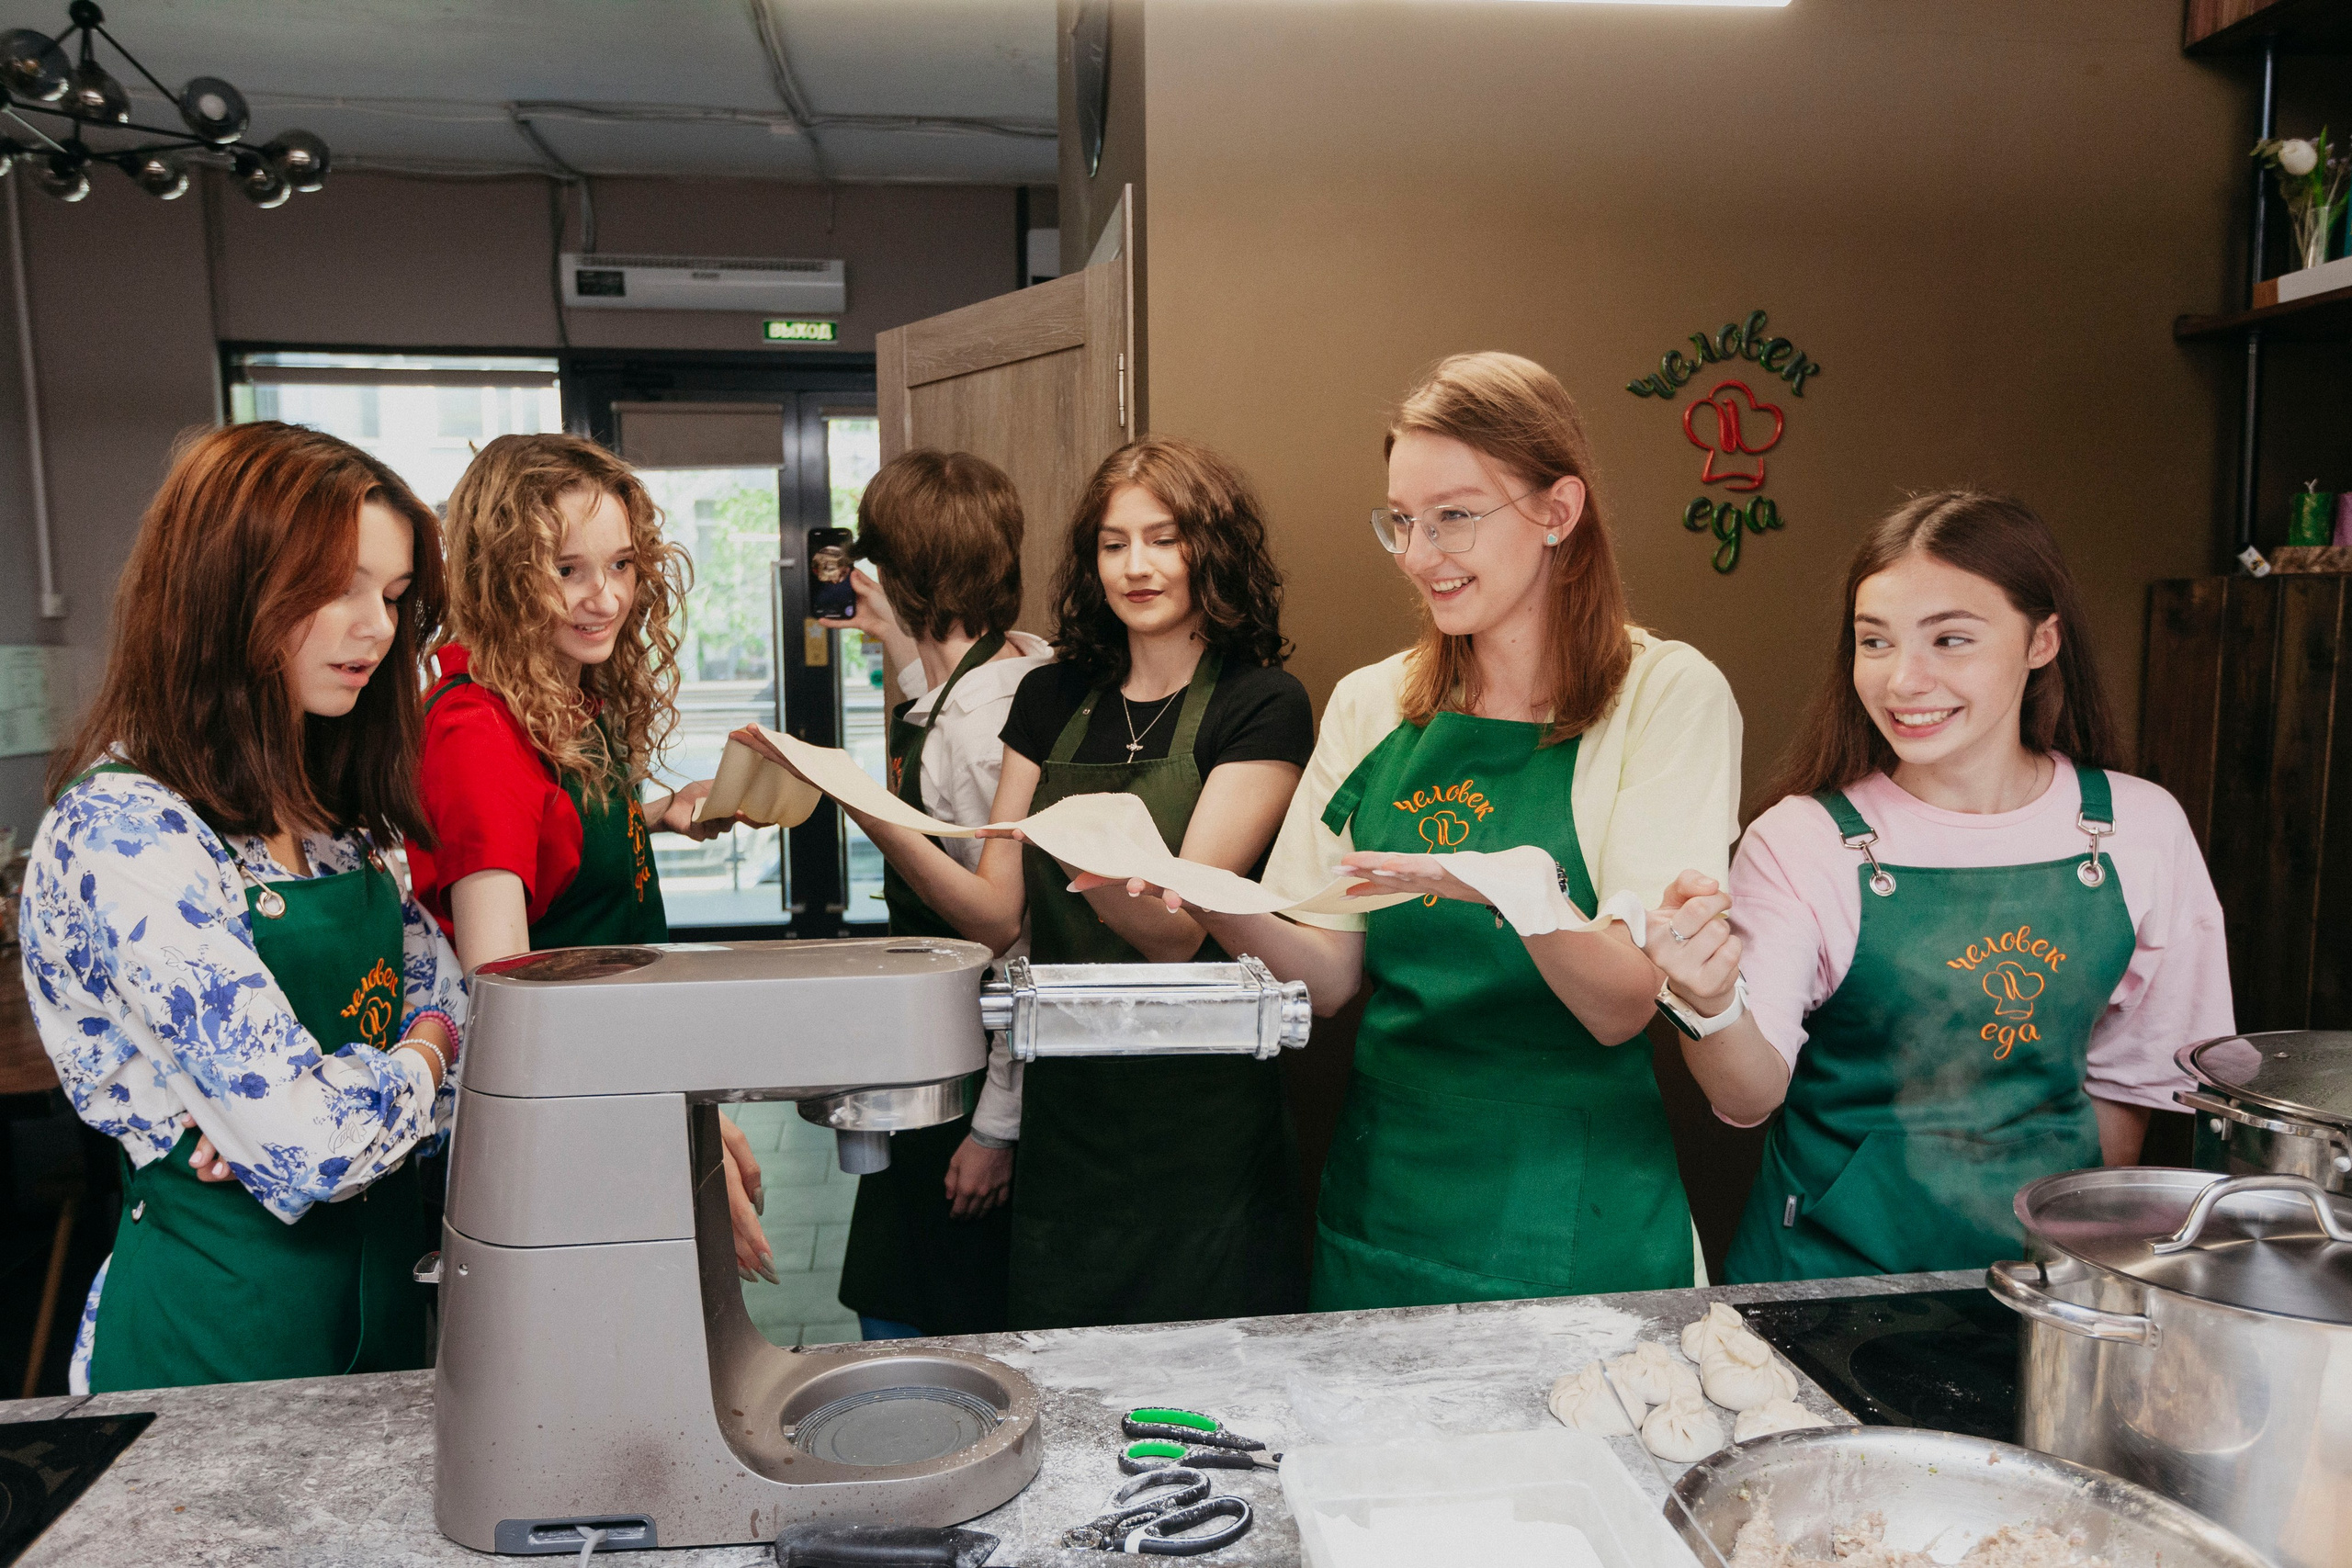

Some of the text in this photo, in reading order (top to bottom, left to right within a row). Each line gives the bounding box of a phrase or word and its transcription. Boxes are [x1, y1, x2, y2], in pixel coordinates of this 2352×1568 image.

[769, 321, 833, 340] ВЫХОД
[1626, 309, 1820, 399] человек
[1683, 497, 1784, 573] еда
[1393, 779, 1495, 822] человек
[1946, 925, 2067, 974] человек
[340, 958, 399, 1018] человек
[1980, 1022, 2041, 1060] еда
